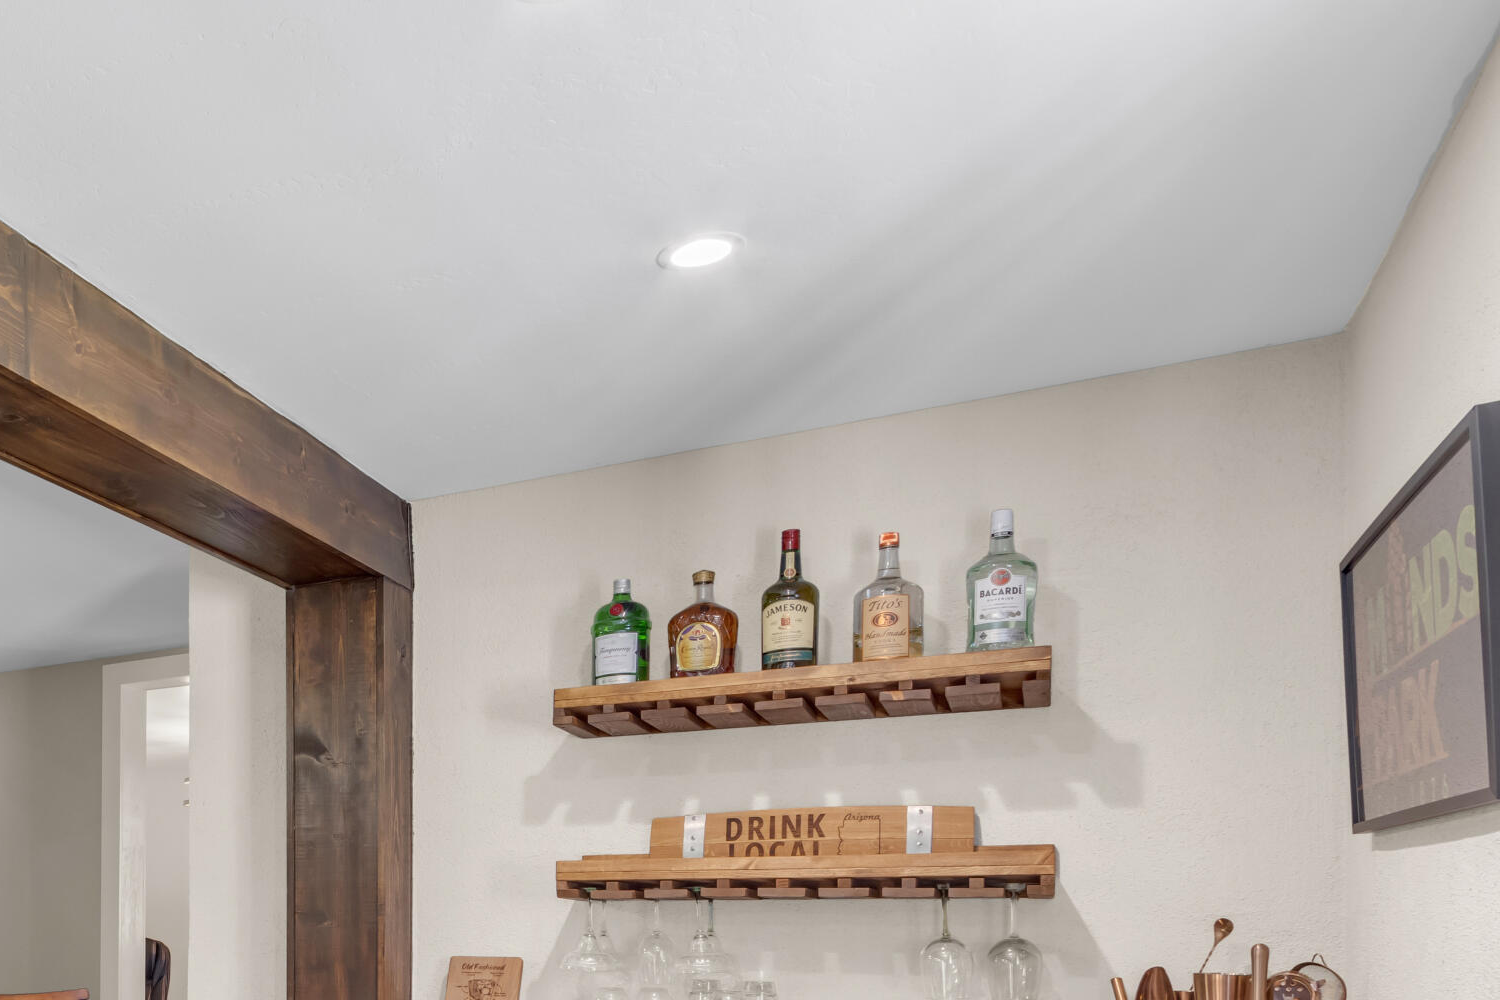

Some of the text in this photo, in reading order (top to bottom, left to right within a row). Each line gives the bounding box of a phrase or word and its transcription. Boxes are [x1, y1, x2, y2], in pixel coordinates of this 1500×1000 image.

[766, 603, 809, 618] JAMESON
[868, 598, 905, 612] Tito's
[844, 813, 881, 823] Arizona
[726, 813, 826, 842] DRINK
